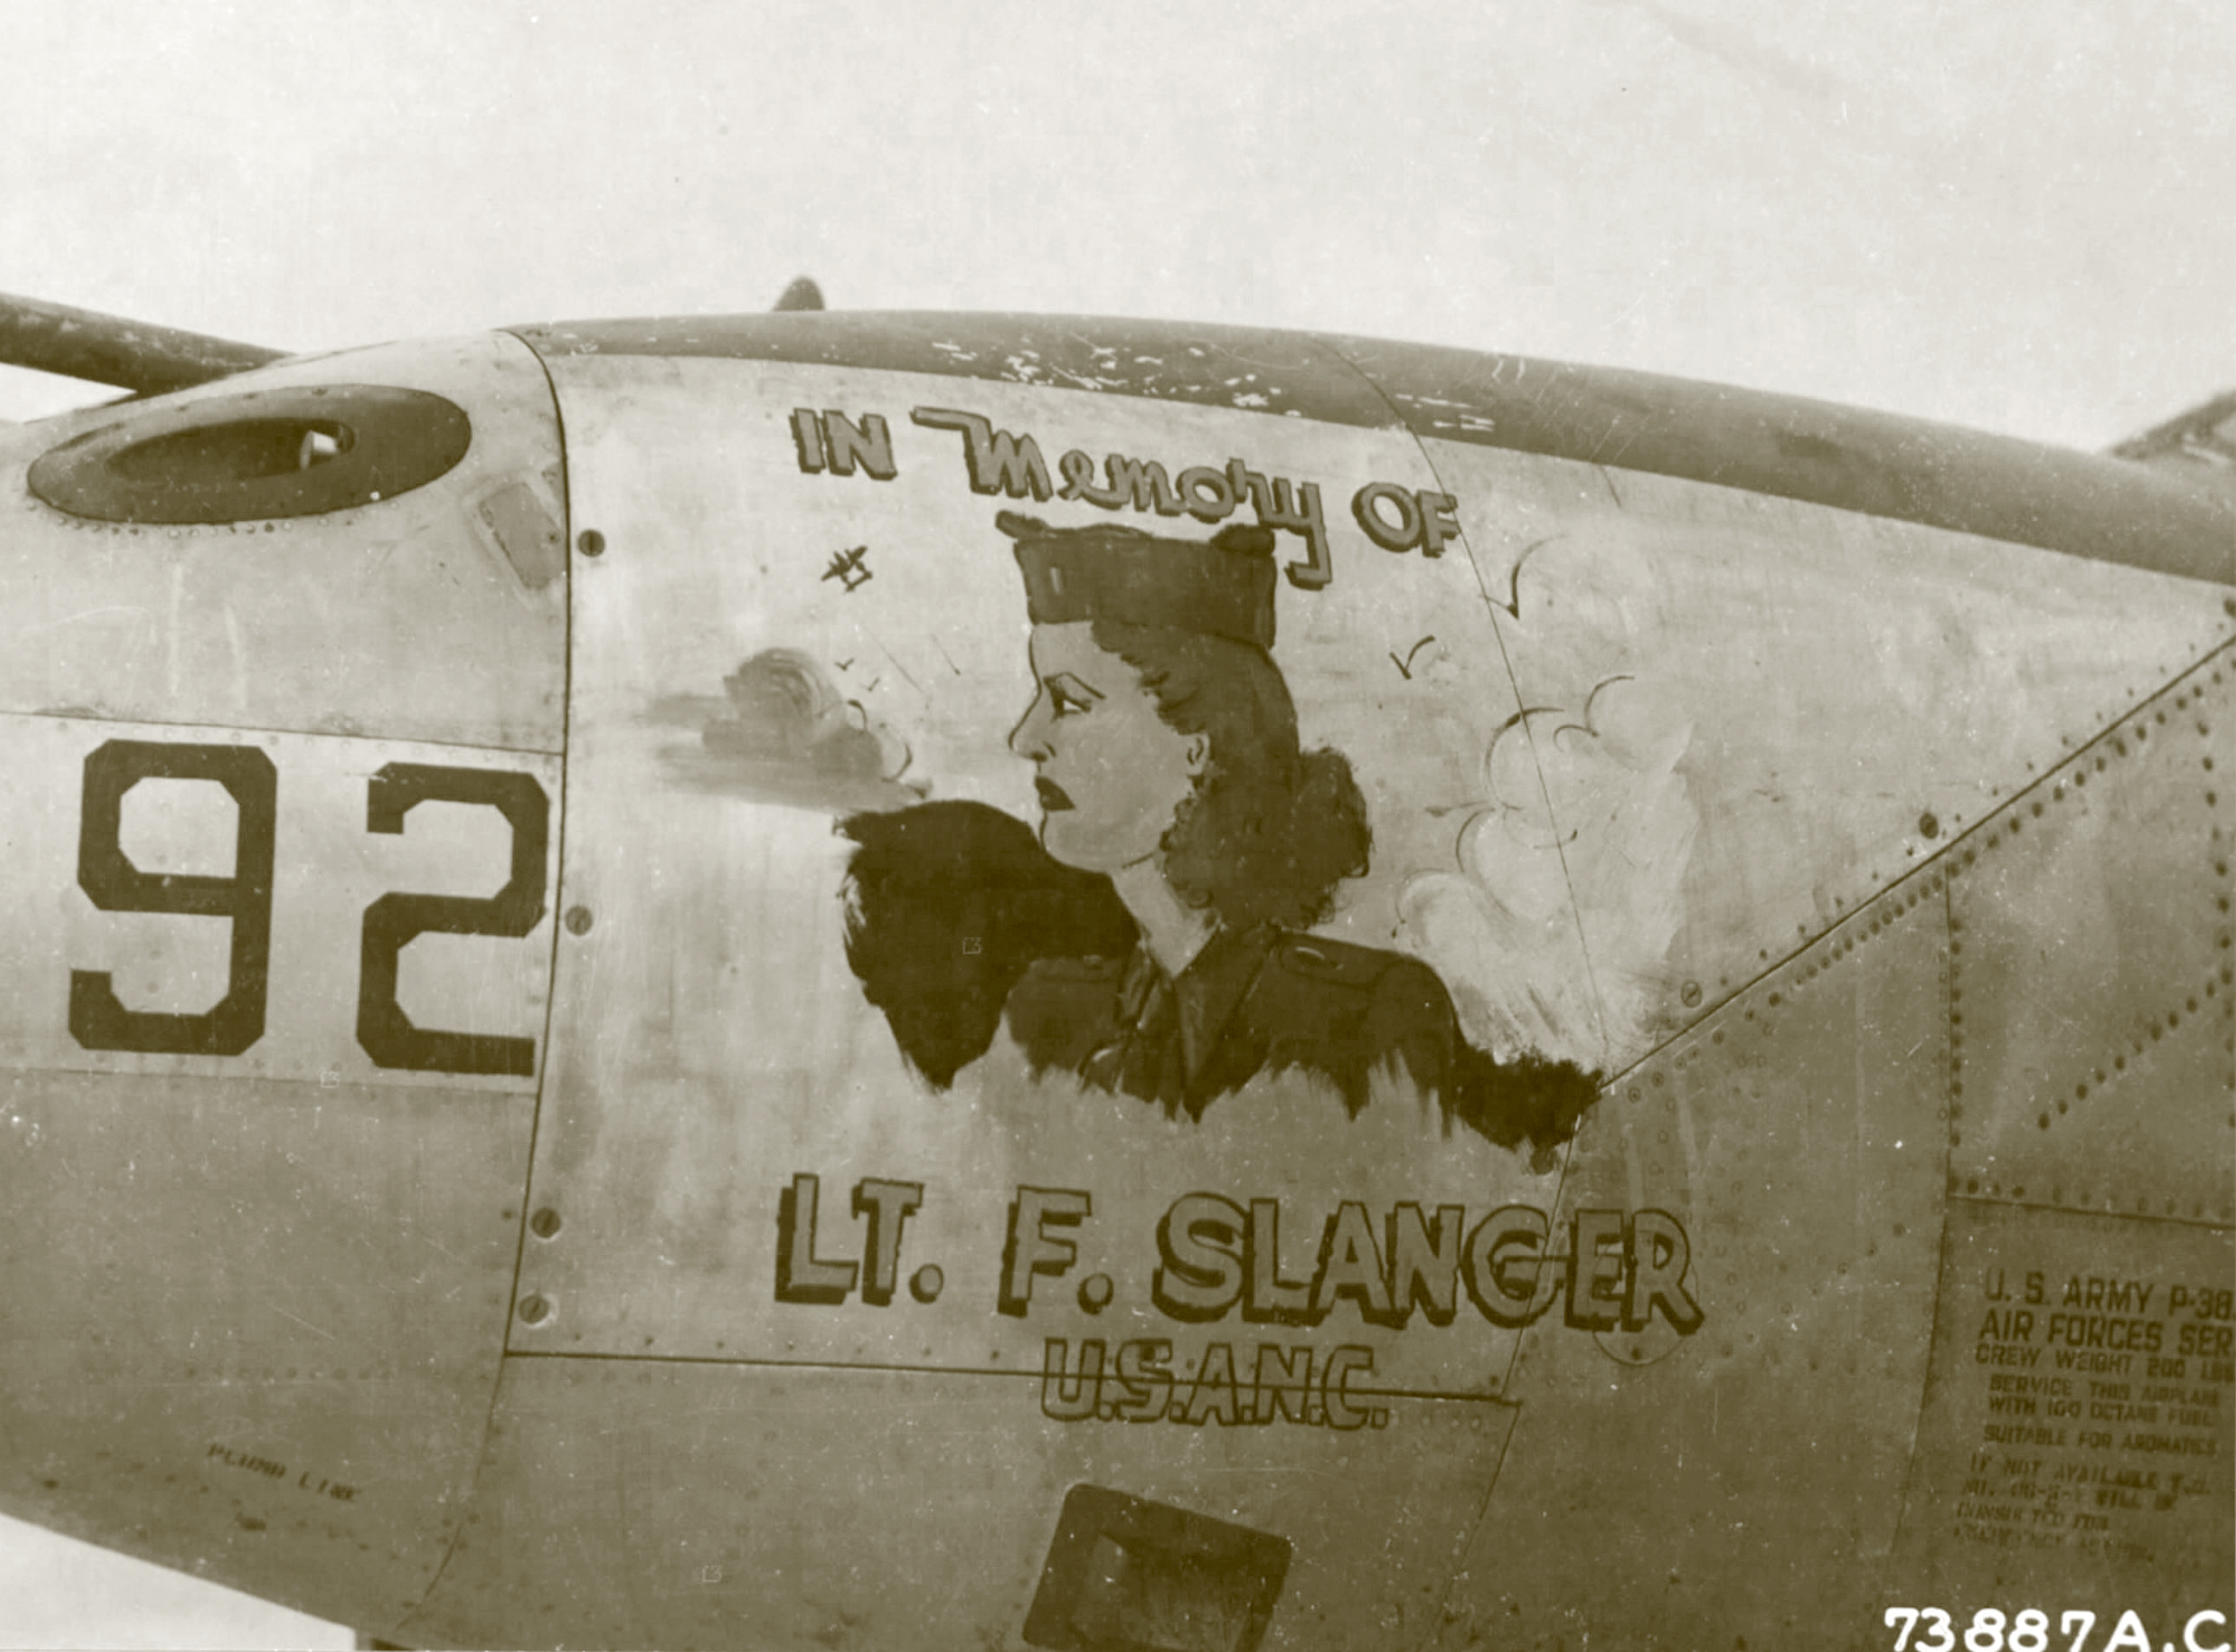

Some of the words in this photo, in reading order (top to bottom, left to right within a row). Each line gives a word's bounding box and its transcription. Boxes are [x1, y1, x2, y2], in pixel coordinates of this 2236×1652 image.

[790, 407, 898, 480] IN
[910, 406, 1332, 590] Memory
[1352, 481, 1462, 557] OF
[68, 738, 550, 1076] 92
[775, 1172, 944, 1308] LT.
[997, 1183, 1115, 1318] F.
[1150, 1191, 1706, 1336] SLANGER
[2062, 1274, 2155, 1314] ARMY
[1979, 1307, 2035, 1343] AIR
[2048, 1311, 2164, 1353] FORCES
[1975, 1343, 2042, 1368] CREW
[2055, 1350, 2134, 1376] WEIGHT
[1041, 1337, 1388, 1431] U.S.A.N.C.
[1989, 1373, 2072, 1398] SERVICE
[1989, 1395, 2037, 1416] WITH
[1983, 1423, 2068, 1447] SUITABLE
[2077, 1430, 2113, 1450] FOR
